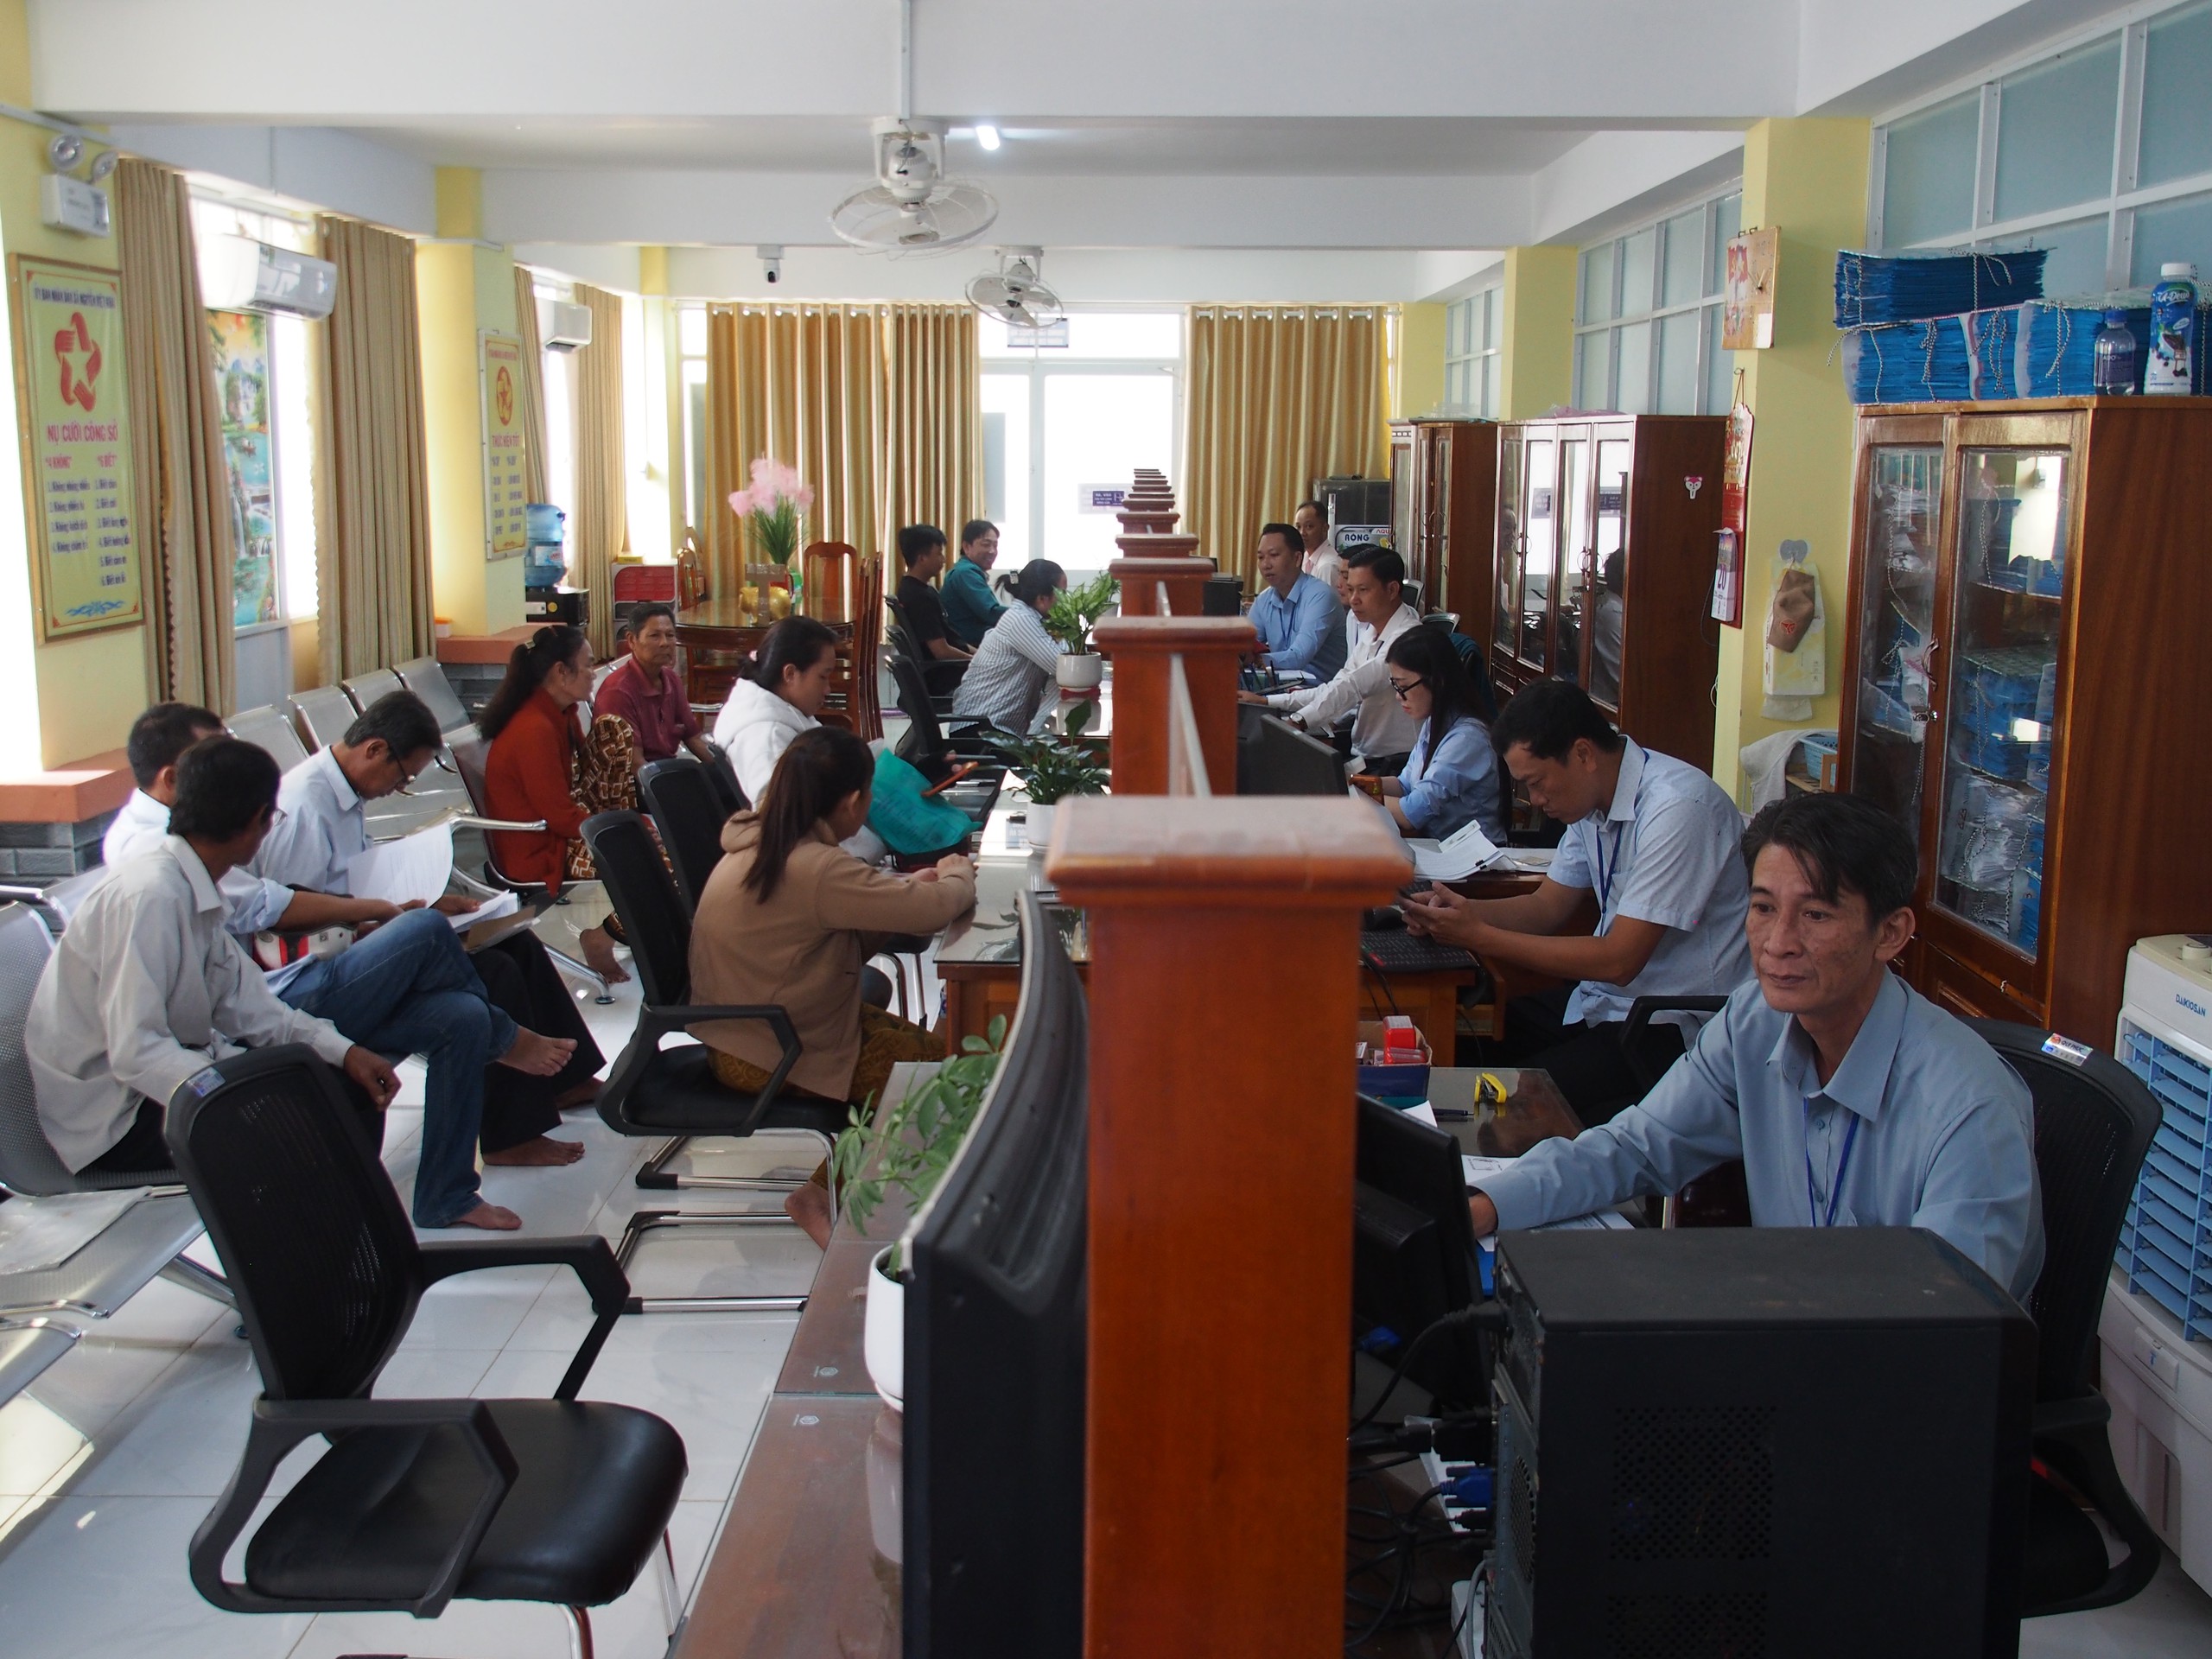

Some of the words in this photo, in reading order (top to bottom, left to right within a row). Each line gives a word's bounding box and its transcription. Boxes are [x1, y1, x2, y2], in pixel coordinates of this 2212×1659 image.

[48, 424, 60, 445] NỤ
[62, 420, 82, 442] CƯỜI
[84, 420, 105, 442] CÔNG
[1717, 563, 1726, 589] 20
[2176, 994, 2206, 1016] DAIKIOSAN
